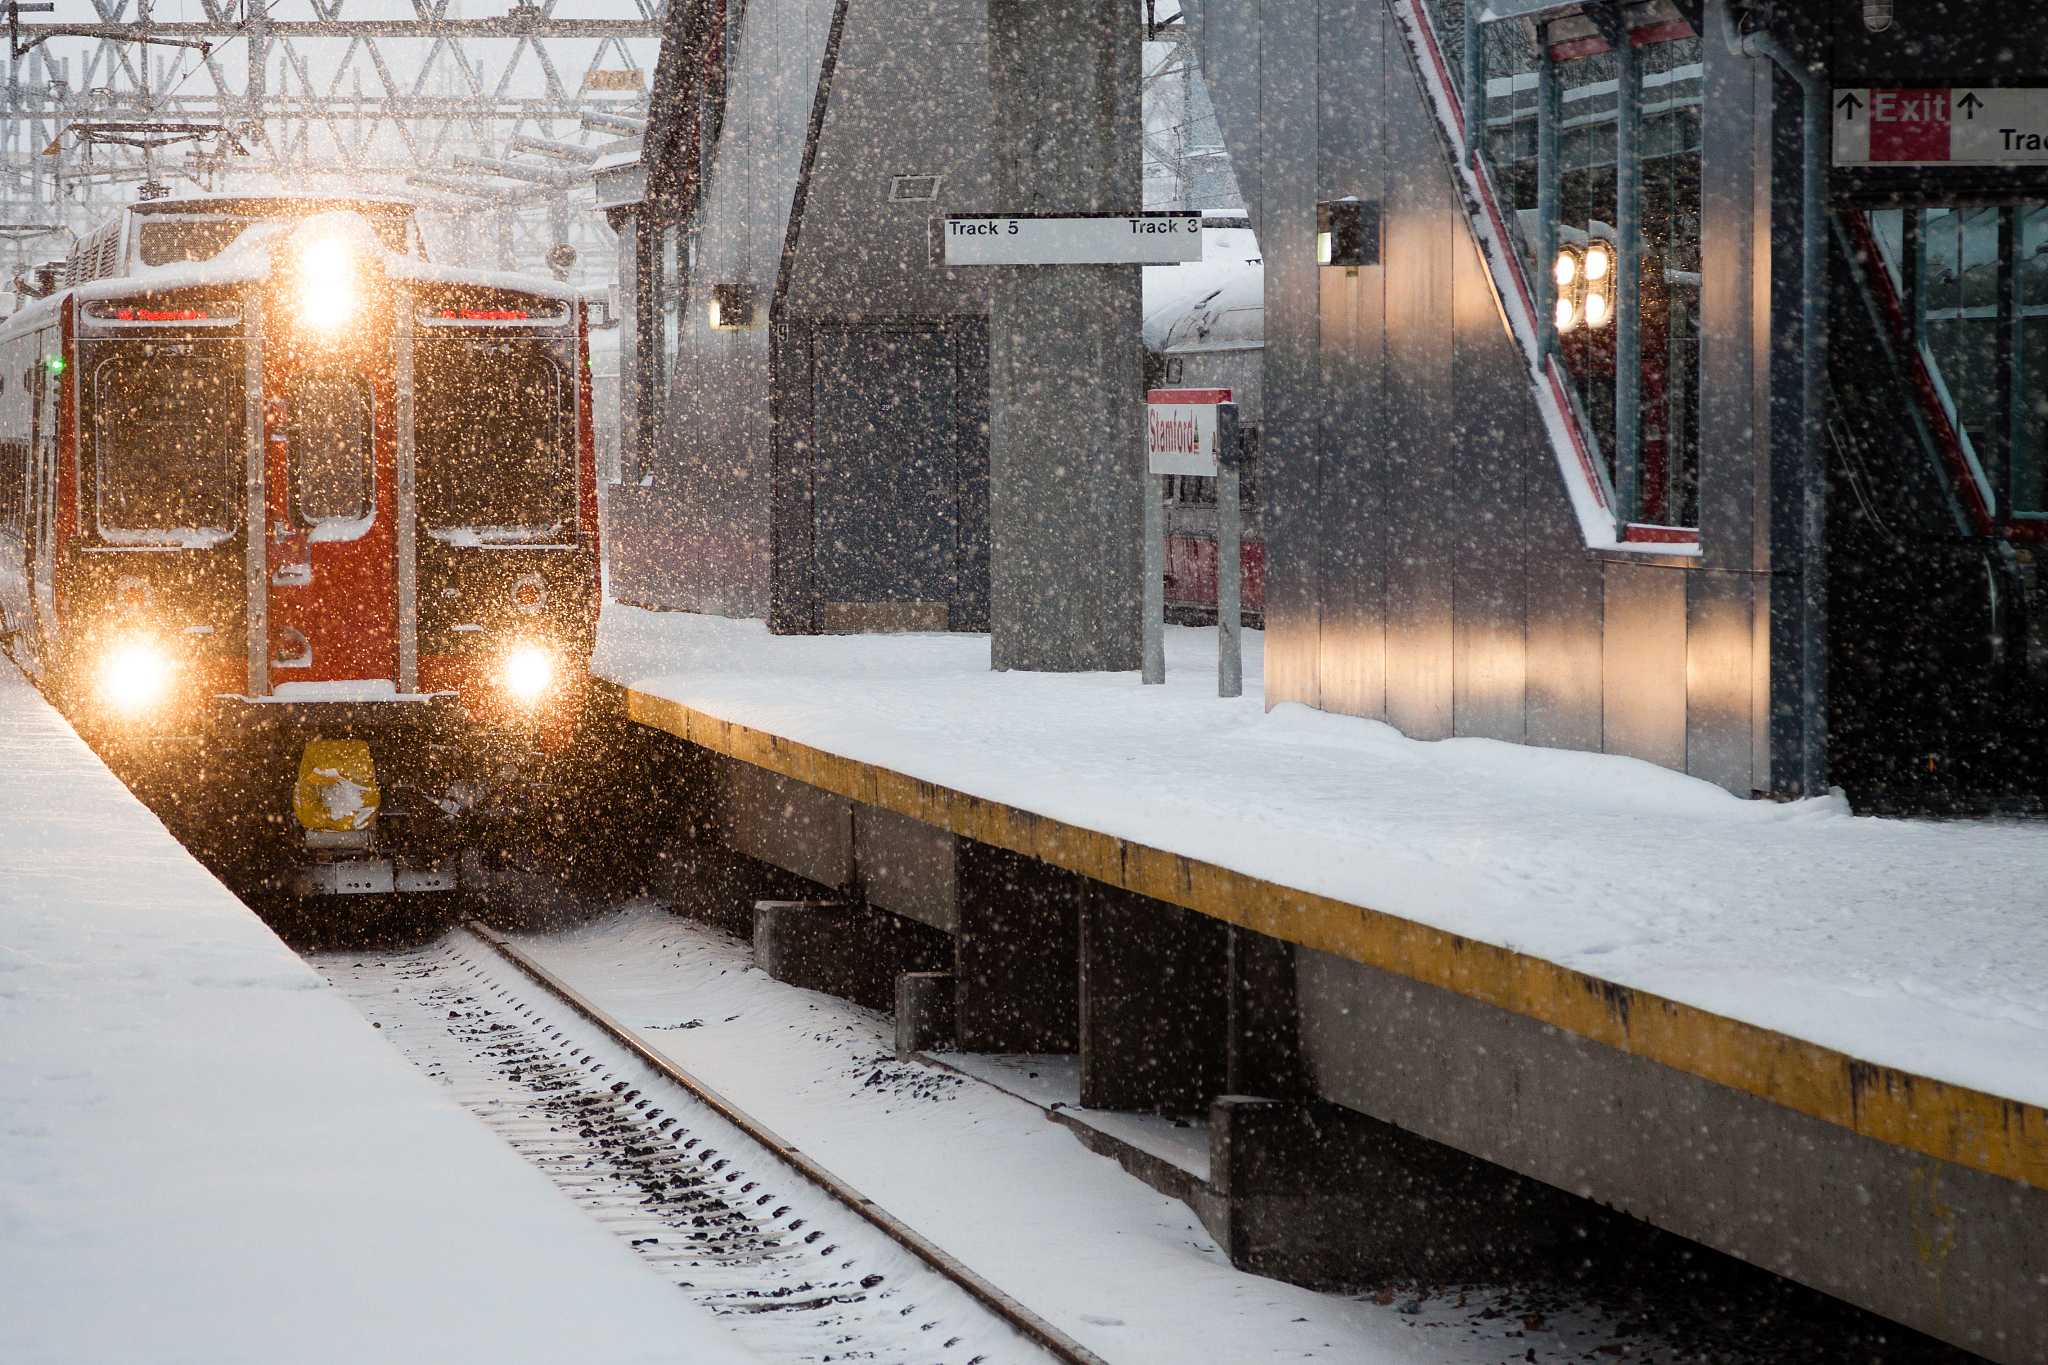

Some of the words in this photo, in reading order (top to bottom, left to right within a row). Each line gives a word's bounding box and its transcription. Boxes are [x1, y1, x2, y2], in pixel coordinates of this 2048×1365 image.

[1876, 93, 1946, 122] Exit
[949, 221, 999, 235] Track
[1008, 221, 1019, 235] 5
[1129, 219, 1178, 233] Track
[1187, 219, 1198, 233] 3
[118, 309, 133, 320] No
[138, 308, 207, 320] Passengers
[442, 308, 456, 319] No
[461, 308, 527, 320] Passengers
[1150, 408, 1193, 453] Stamford
